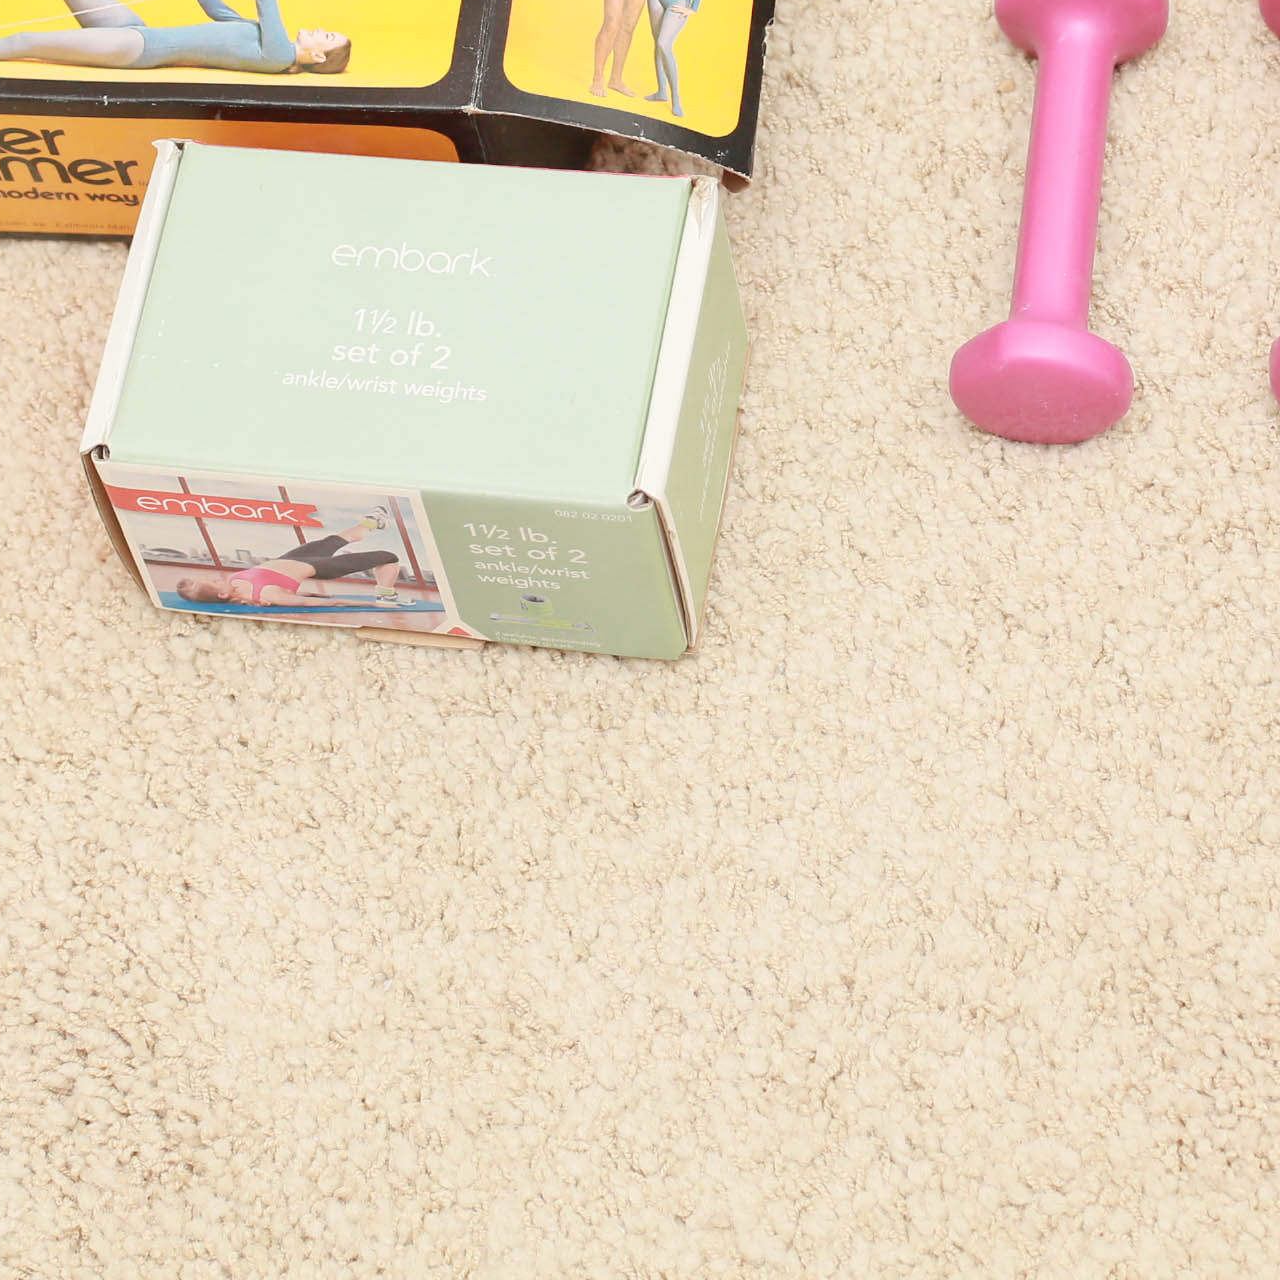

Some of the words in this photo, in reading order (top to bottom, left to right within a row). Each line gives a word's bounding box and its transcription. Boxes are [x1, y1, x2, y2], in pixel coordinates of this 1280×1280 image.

[84, 191, 140, 207] way
[331, 241, 494, 277] embark
[407, 311, 441, 337] lb.
[331, 343, 381, 364] set
[389, 342, 425, 366] of
[430, 345, 452, 370] 2
[282, 368, 399, 394] ankle/wrist
[404, 381, 488, 404] weights
[136, 496, 299, 522] embark
[519, 526, 558, 544] lb.
[469, 543, 516, 558] set
[527, 546, 558, 561] of
[568, 549, 588, 564] 2
[474, 560, 592, 580] ankle/wrist
[477, 574, 561, 590] weights
